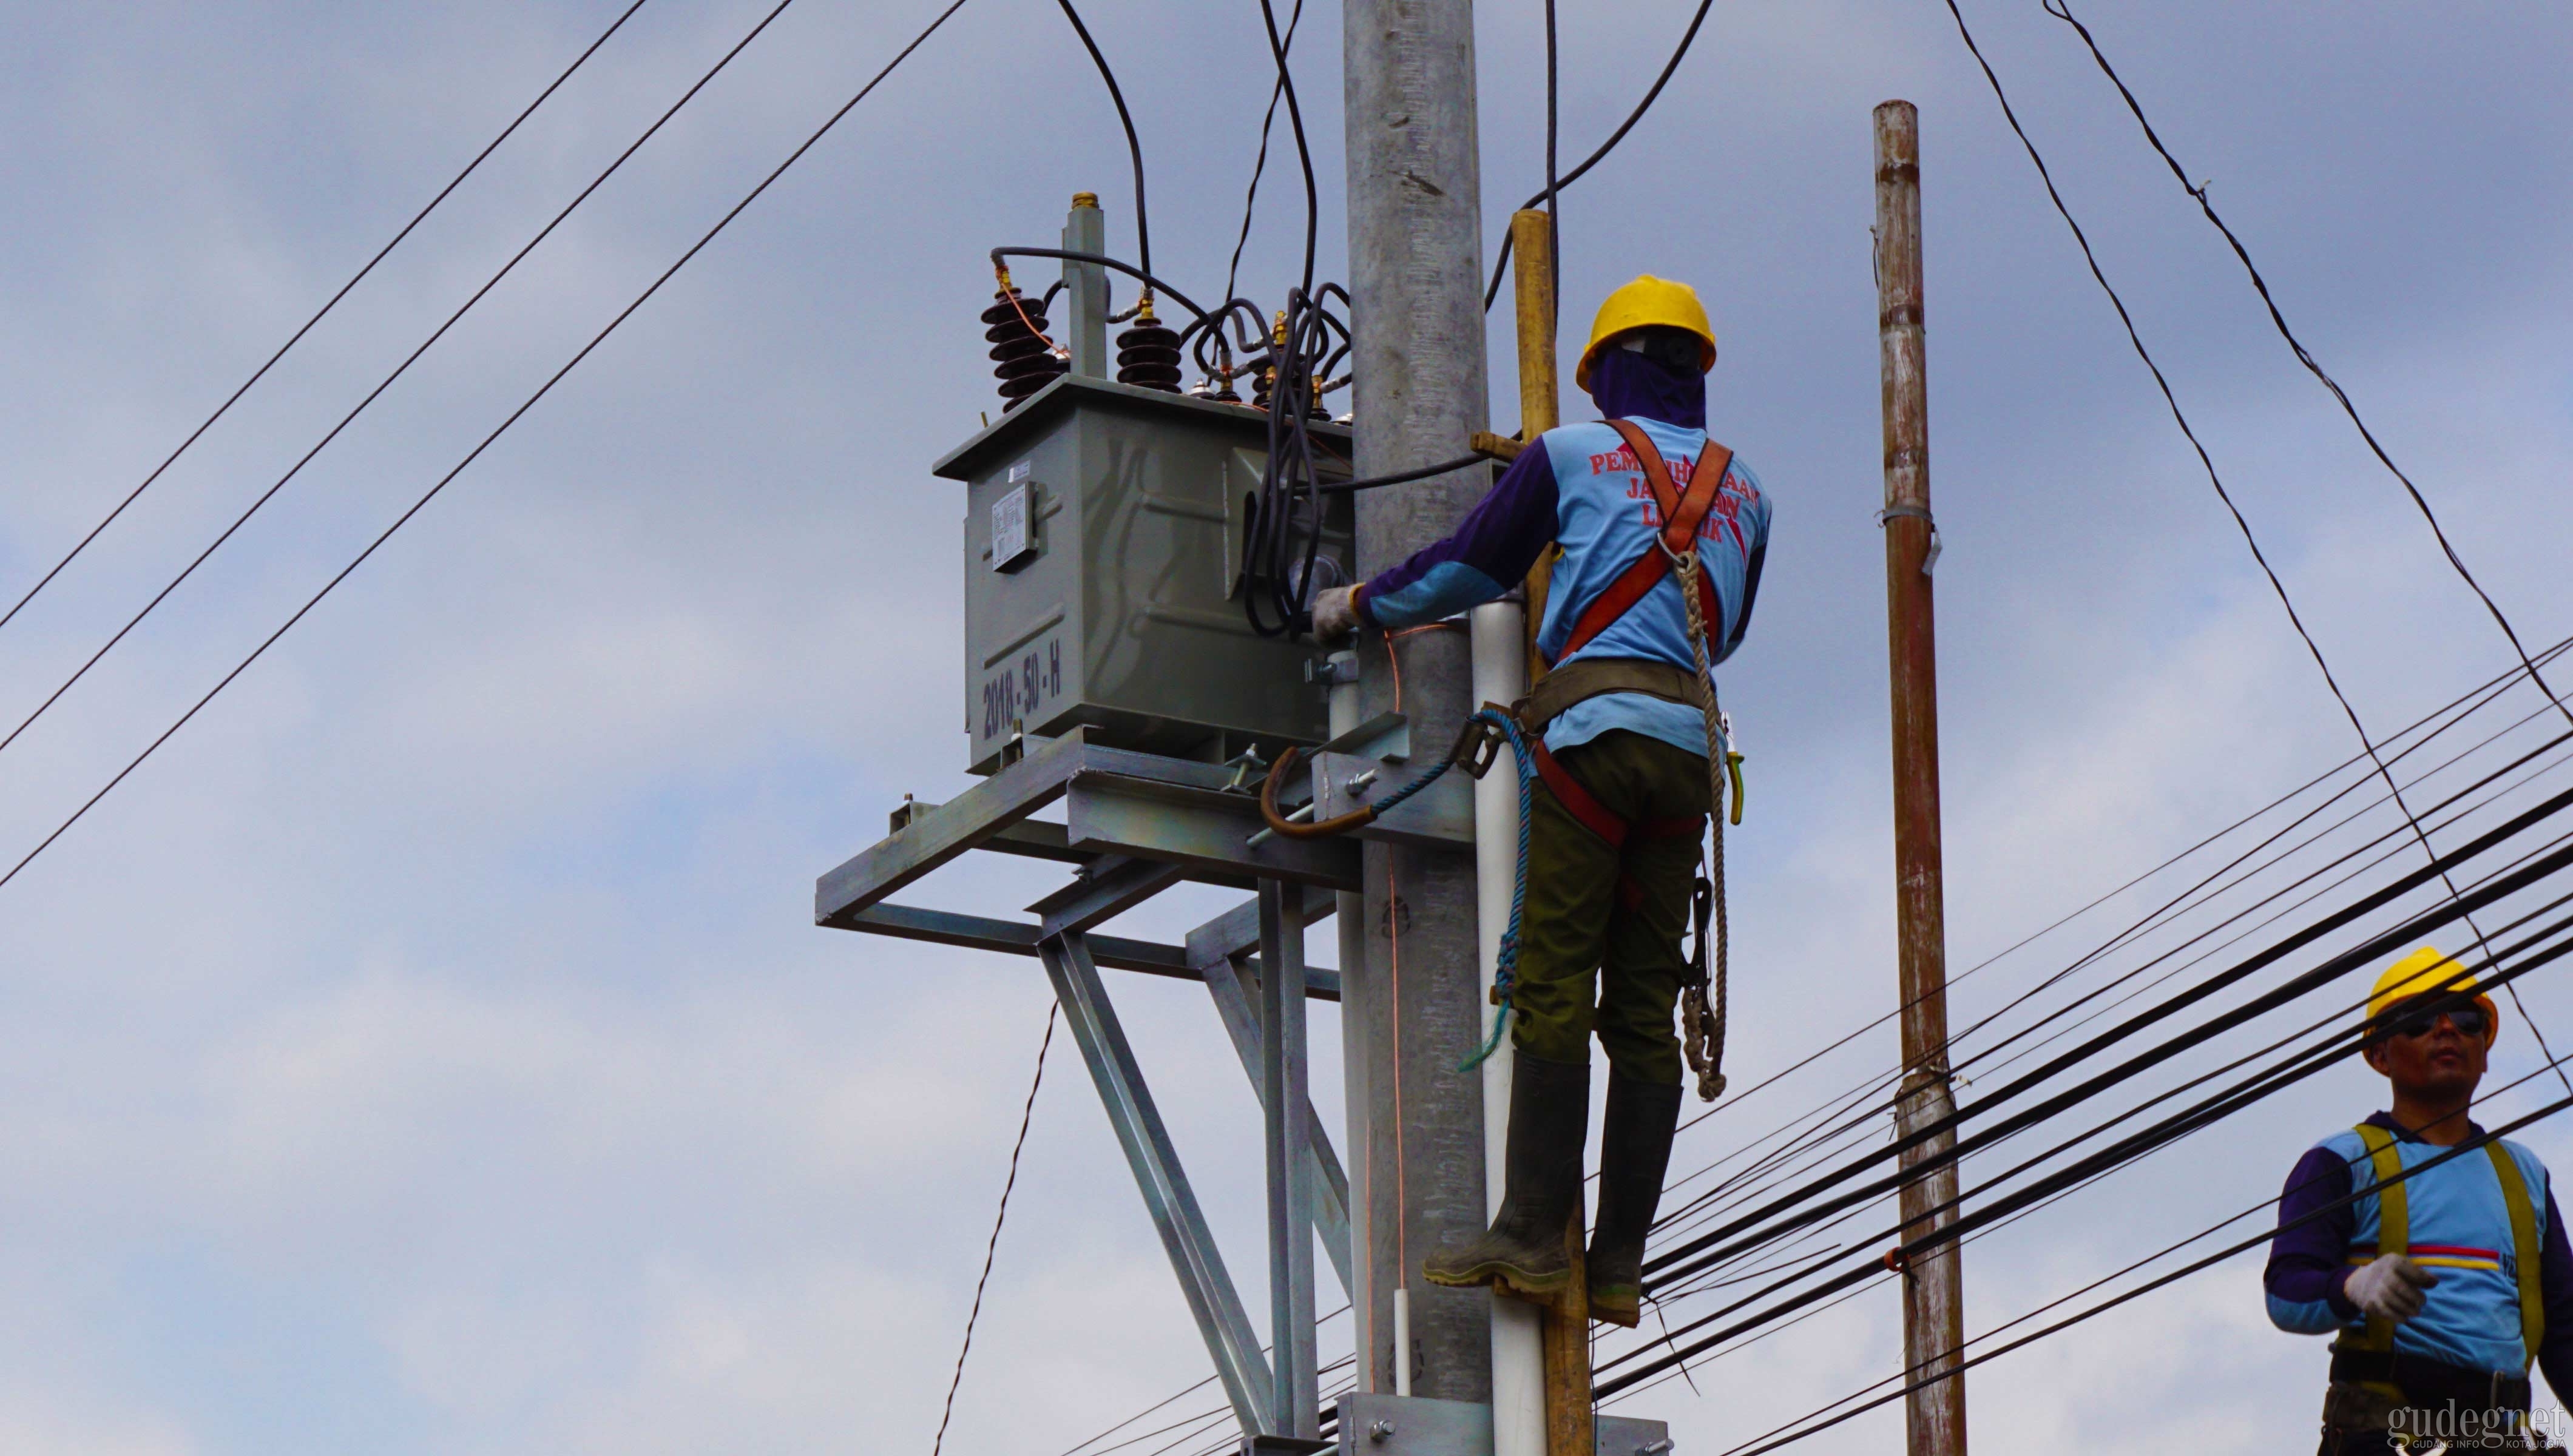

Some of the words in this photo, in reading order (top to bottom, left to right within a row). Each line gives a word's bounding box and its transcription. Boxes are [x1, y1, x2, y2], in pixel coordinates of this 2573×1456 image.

[1589, 451, 1760, 510] PEMIHAAN
[1626, 477, 1740, 520] JAAN
[1642, 504, 1723, 544] LIIK
